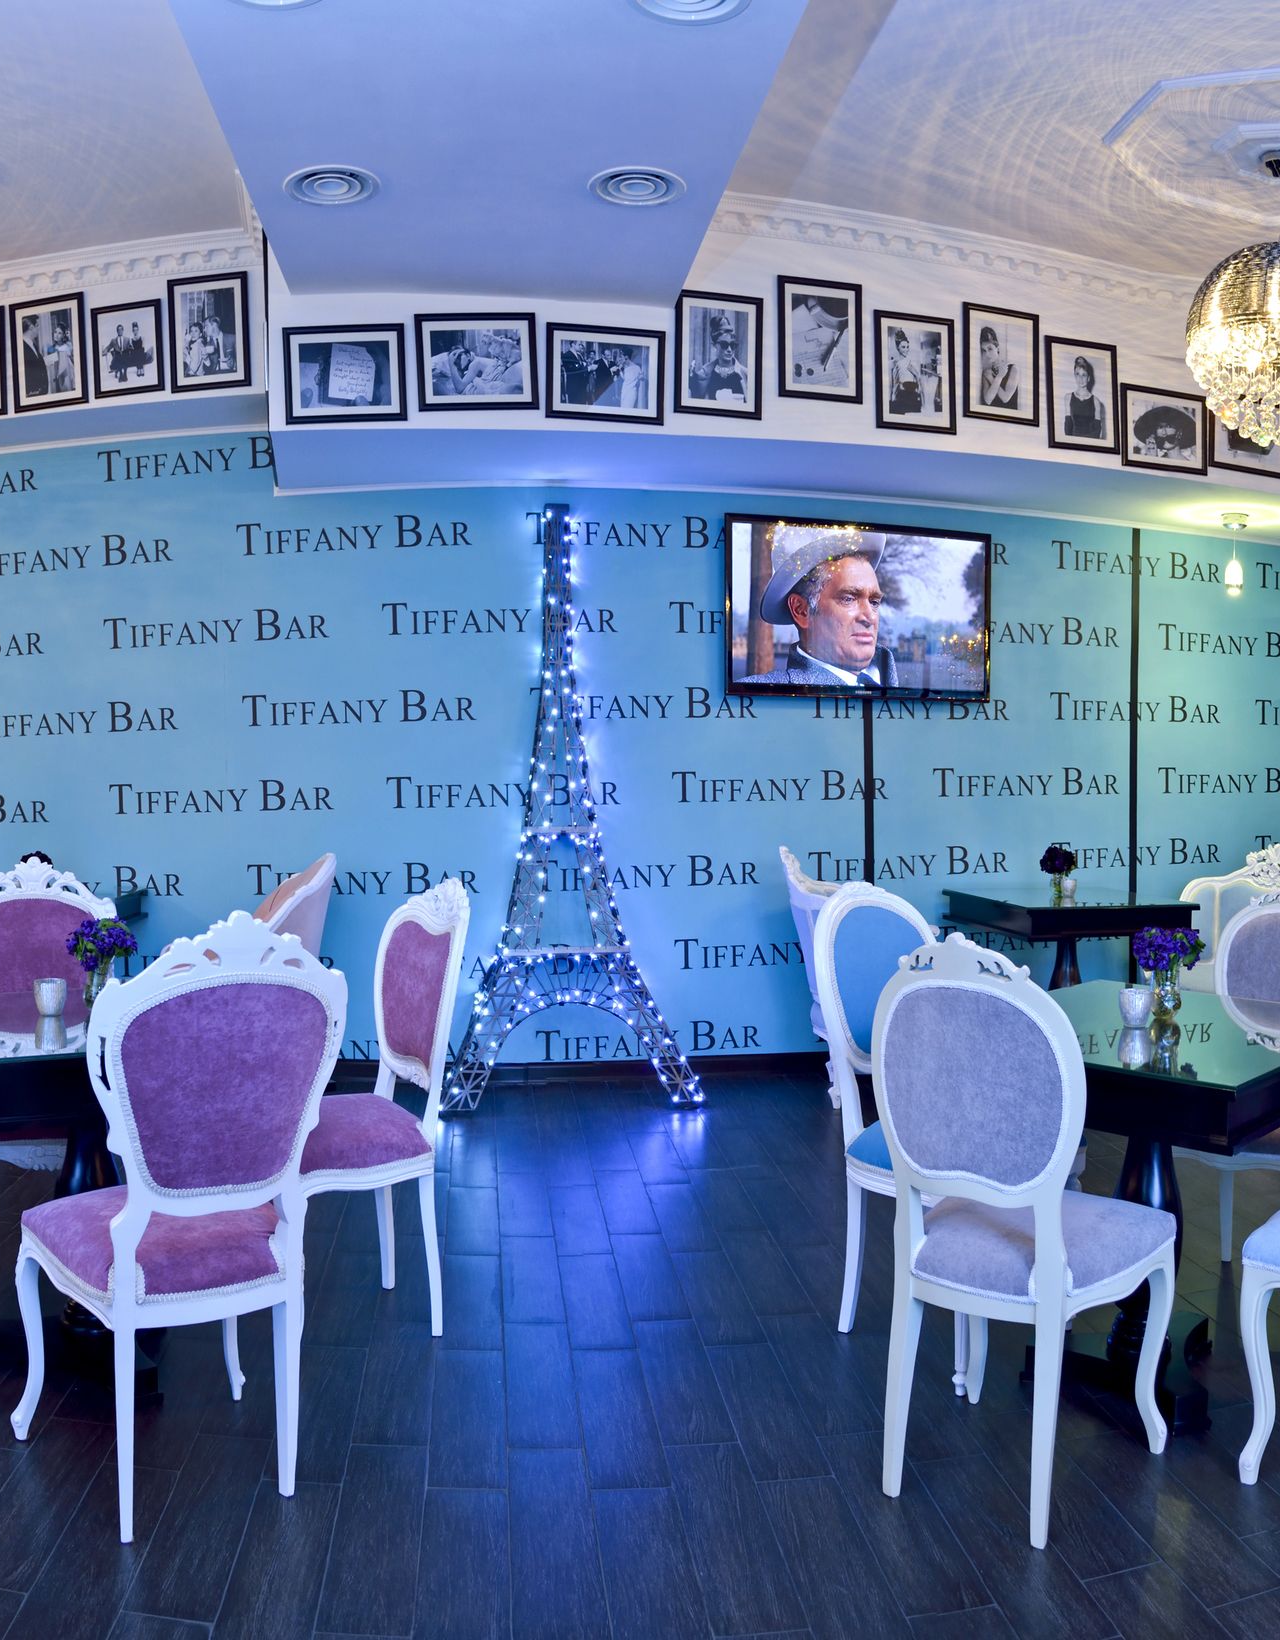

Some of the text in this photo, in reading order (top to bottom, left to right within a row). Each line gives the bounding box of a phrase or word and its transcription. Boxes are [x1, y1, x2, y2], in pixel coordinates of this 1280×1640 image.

[97, 447, 236, 483] TIFFANY
[236, 514, 472, 556] TIFFANY BAR
[526, 512, 672, 548] TFFANY
[101, 534, 174, 567] BAR
[1168, 552, 1220, 583] BAR
[103, 608, 330, 651] TIFFANY BAR
[381, 602, 531, 636] TIFFANY
[1061, 616, 1120, 648] BAR
[1158, 623, 1258, 656] TIFFANY
[107, 701, 178, 733] BAR
[242, 690, 477, 727] TIFFANY BAR
[685, 686, 758, 719] BAR
[812, 697, 934, 720] TIFANY
[1168, 695, 1220, 724] BAR
[386, 774, 620, 809] TIFFANY BAR
[671, 769, 889, 803] TIFFANY BAR
[932, 767, 1120, 798] TIFFANY BAR
[1158, 767, 1257, 794] TIFFANY
[108, 780, 334, 815] TIFFANY BAR
[808, 845, 1009, 882] TIFANY BAR
[1169, 838, 1221, 865] BAR
[113, 866, 184, 898] BAR
[247, 863, 392, 896] TIANY
[687, 855, 760, 887] BAR
[690, 1020, 762, 1052] BAR
